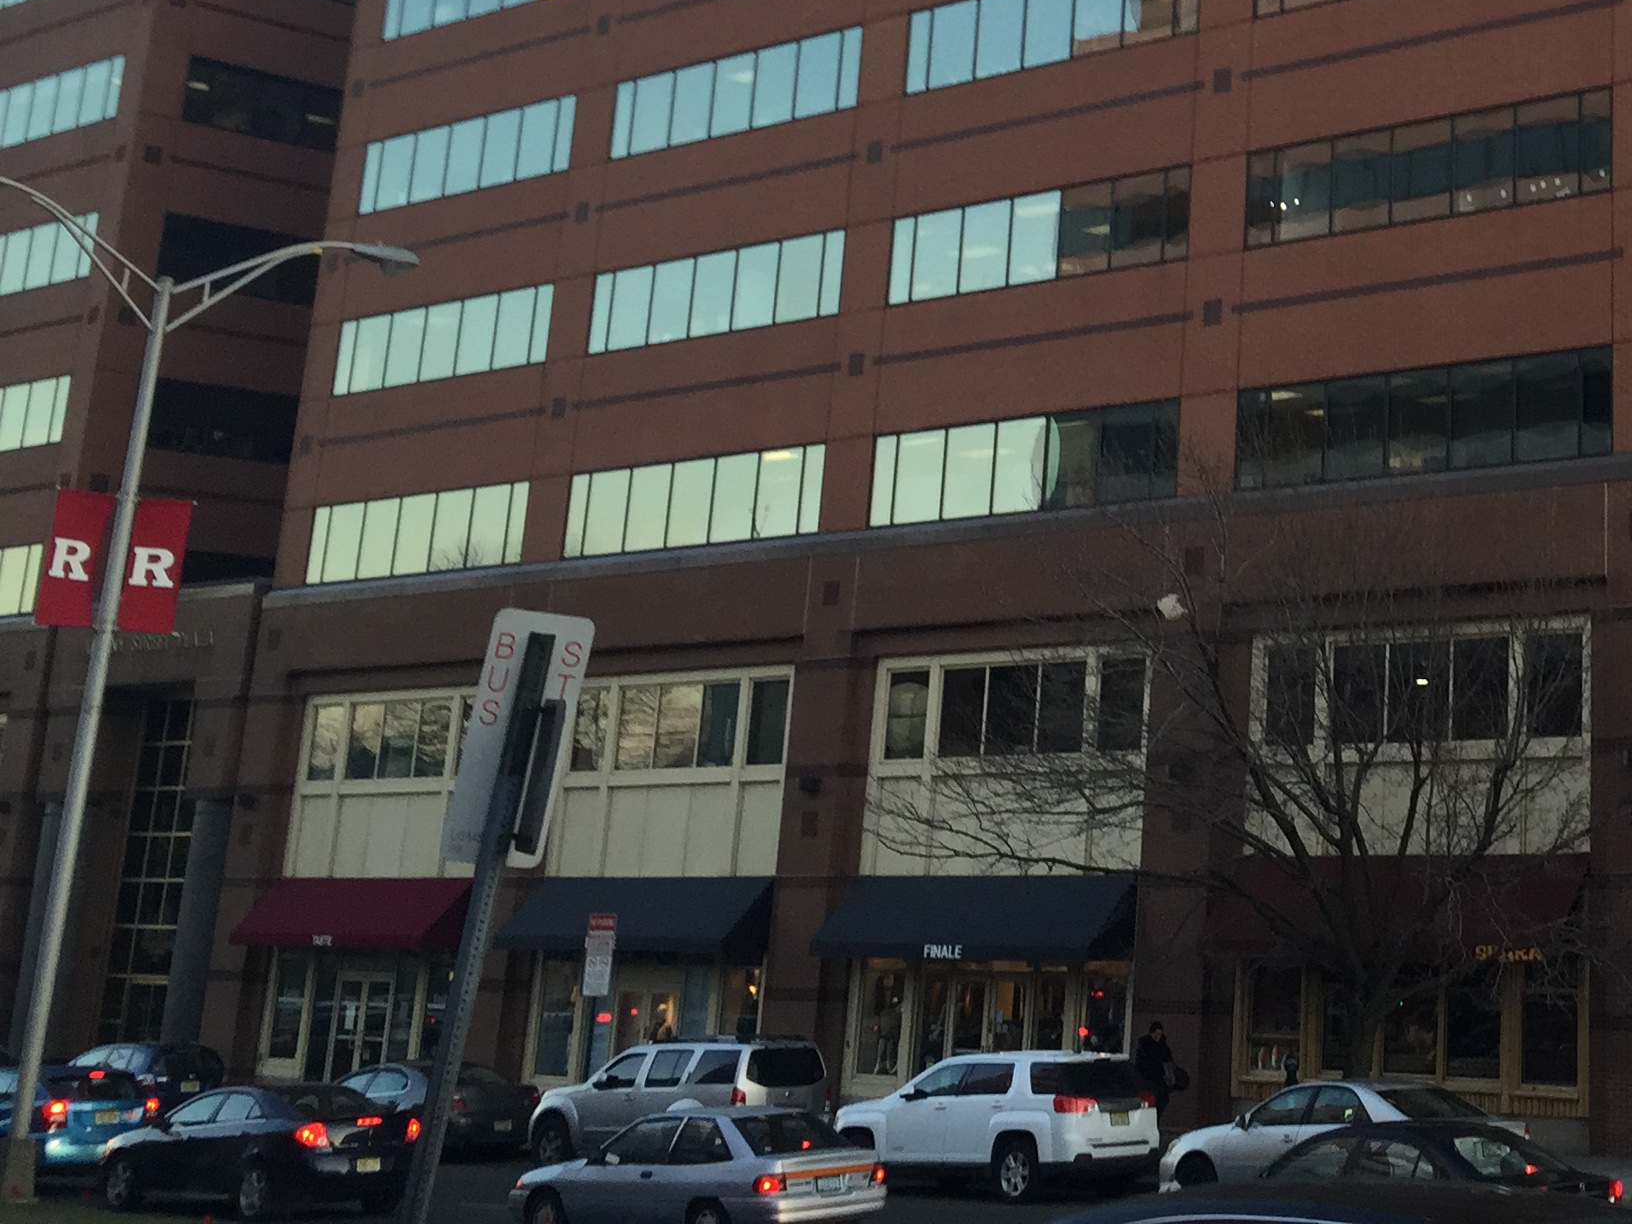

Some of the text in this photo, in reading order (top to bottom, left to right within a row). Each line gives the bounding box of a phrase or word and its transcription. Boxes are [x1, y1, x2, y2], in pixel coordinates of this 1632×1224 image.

[48, 536, 91, 582] R
[128, 546, 175, 589] R
[479, 632, 515, 725] BUS
[923, 944, 962, 959] FINALE
